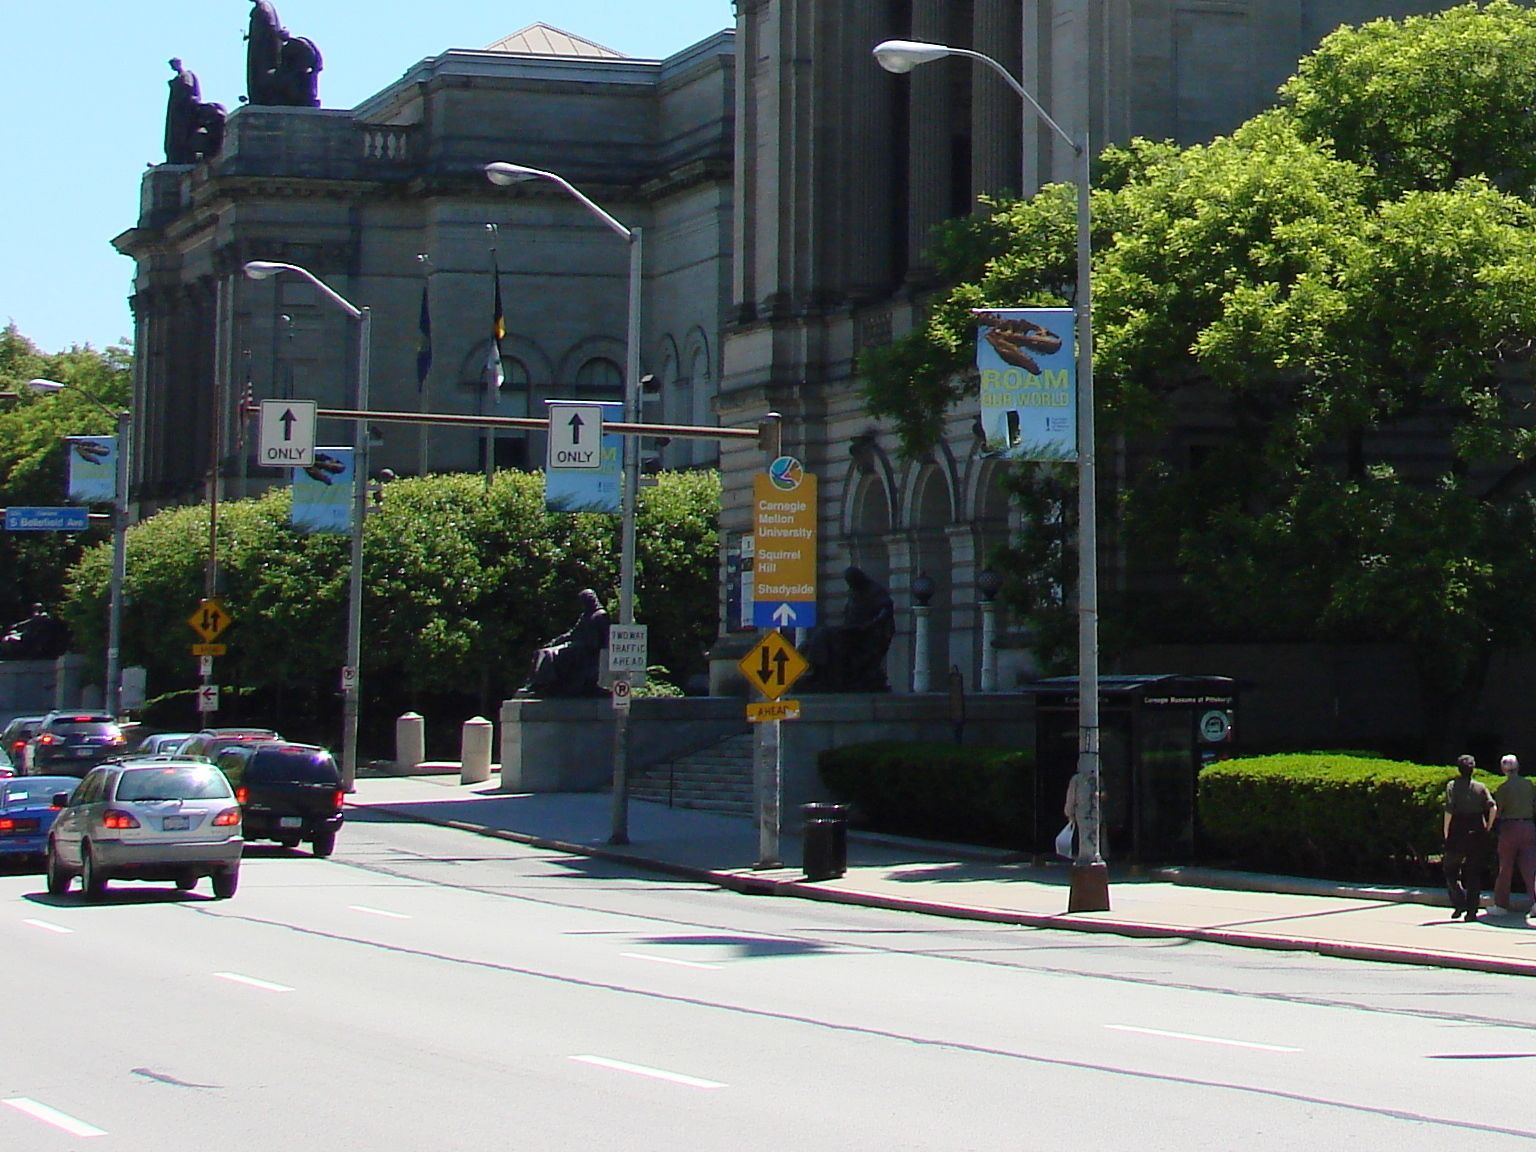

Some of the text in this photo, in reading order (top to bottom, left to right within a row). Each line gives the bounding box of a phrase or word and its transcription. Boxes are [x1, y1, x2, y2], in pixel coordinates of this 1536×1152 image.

[982, 368, 1069, 391] ROAM
[1017, 392, 1069, 408] WORLD
[267, 448, 305, 460] ONLY
[557, 450, 593, 463] ONLY
[759, 500, 807, 512] Carnegie
[759, 514, 794, 524] Mellon
[759, 528, 812, 539] University
[758, 549, 801, 561] Squirrel
[758, 563, 776, 573] Hill
[758, 584, 814, 596] Shadyside
[612, 643, 646, 653] TRAFFIC
[612, 656, 644, 666] AHEAD
